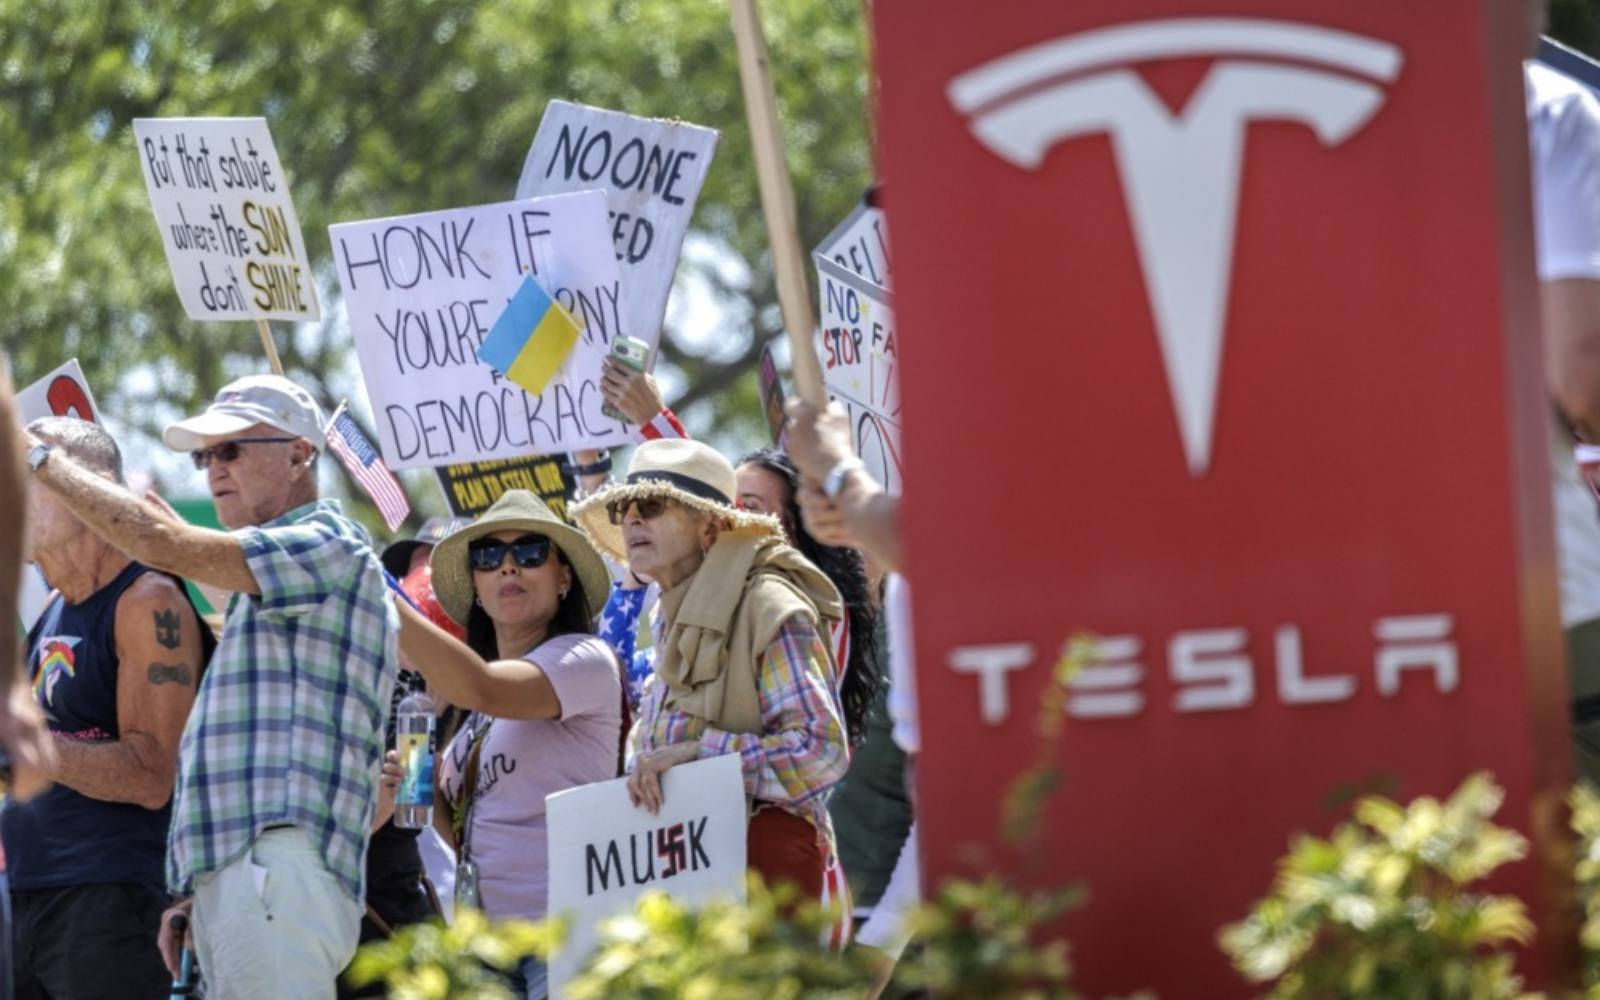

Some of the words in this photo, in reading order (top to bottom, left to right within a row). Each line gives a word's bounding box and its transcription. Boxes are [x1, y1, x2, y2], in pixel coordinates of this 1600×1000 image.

[144, 135, 177, 189] Put
[175, 133, 218, 193] that
[219, 136, 277, 193] salute
[171, 202, 219, 253] where
[210, 203, 250, 258] the
[243, 201, 296, 260] SUN
[340, 217, 492, 291] HONK
[507, 211, 552, 277] IF
[609, 210, 654, 265] ED
[246, 262, 308, 312] SHINE
[826, 279, 861, 325] NO
[823, 327, 863, 370] STOP
[387, 378, 628, 461] DEMOCRAC
[946, 612, 1460, 725] TESLA
